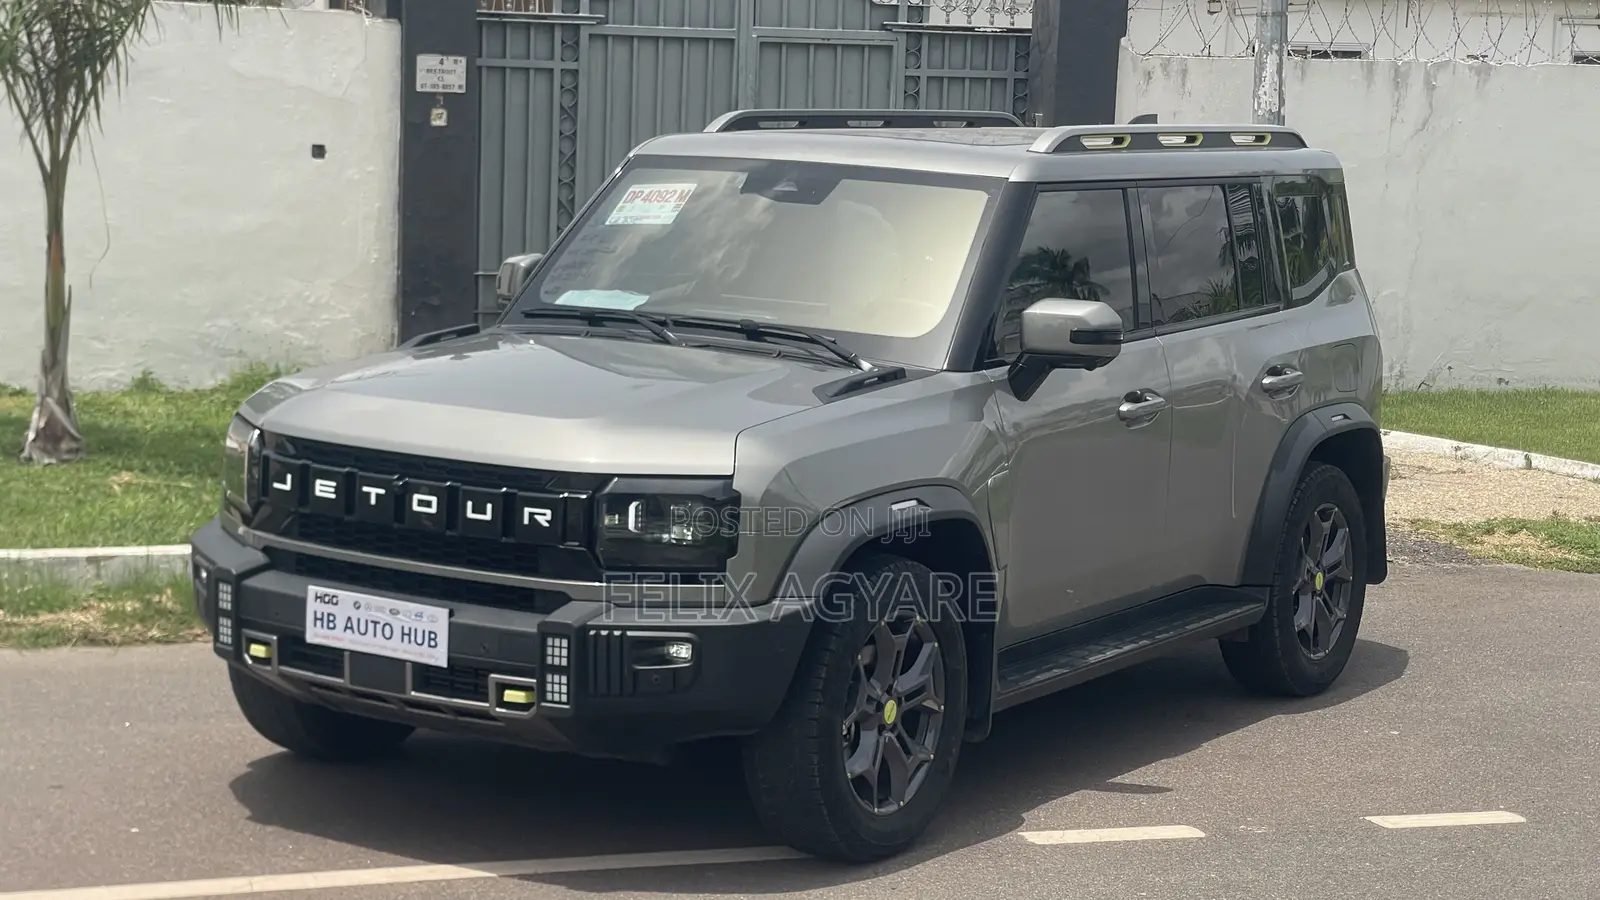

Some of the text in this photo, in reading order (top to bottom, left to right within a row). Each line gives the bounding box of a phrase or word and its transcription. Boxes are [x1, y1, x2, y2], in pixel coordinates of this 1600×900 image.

[622, 189, 692, 204] DP 4092 M
[272, 473, 552, 527] JETOUR
[313, 611, 337, 630] HB
[343, 616, 394, 640] AUTO
[401, 625, 438, 649] HUB
